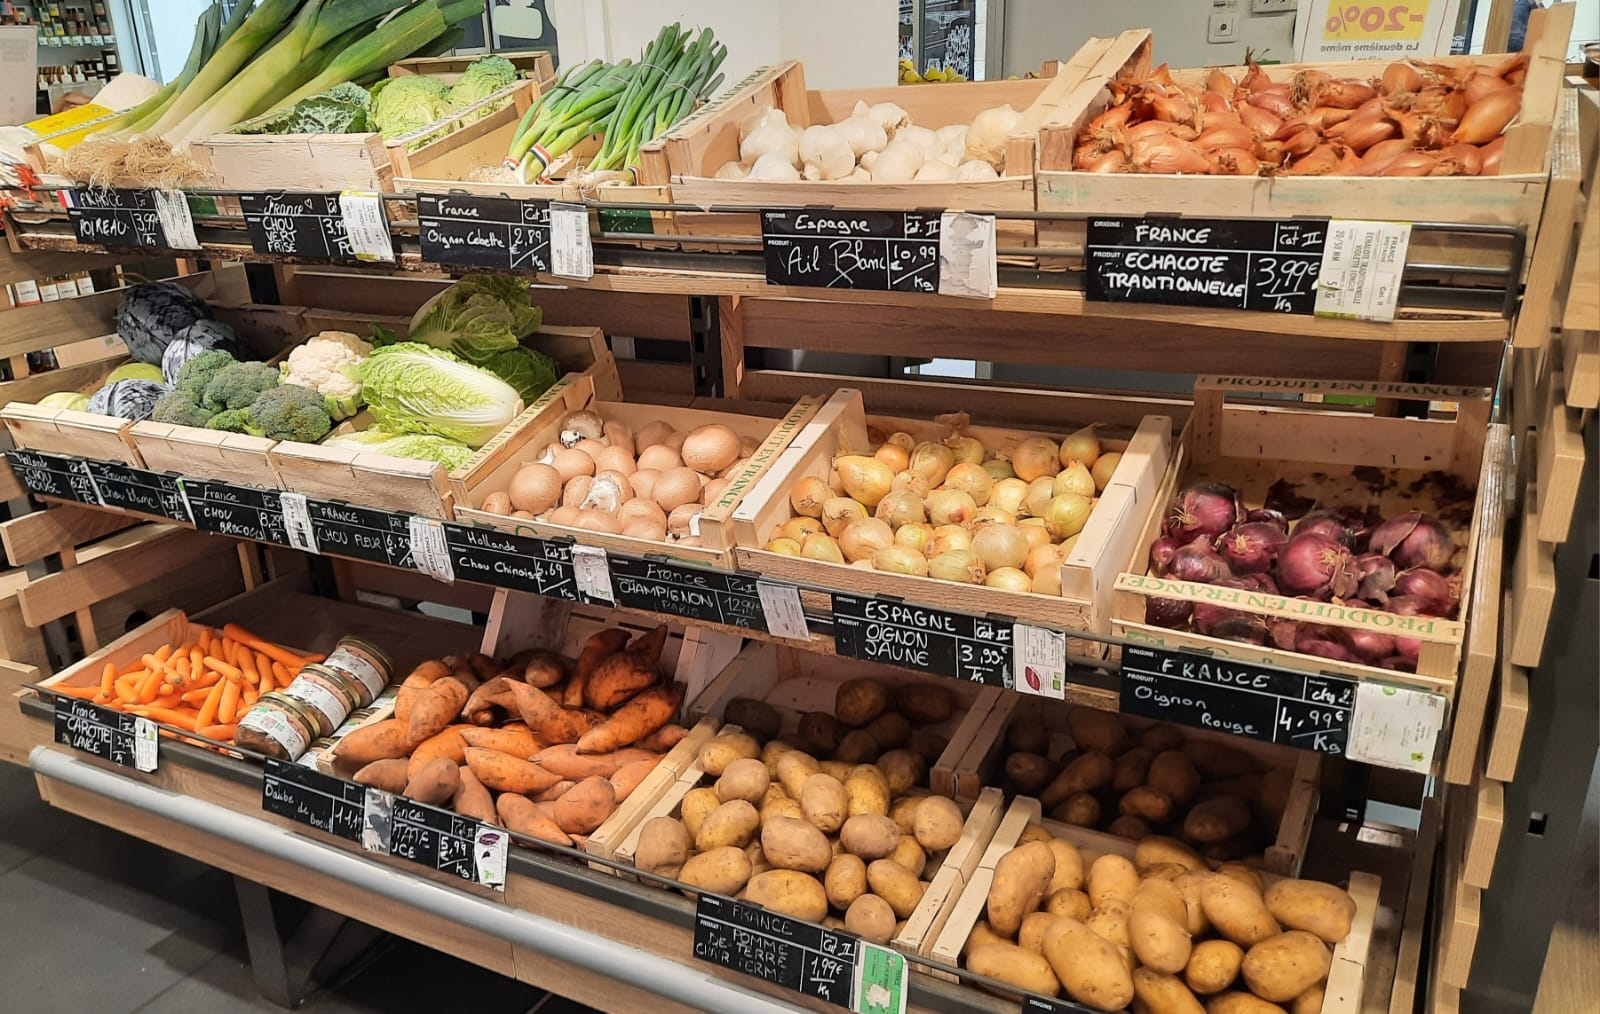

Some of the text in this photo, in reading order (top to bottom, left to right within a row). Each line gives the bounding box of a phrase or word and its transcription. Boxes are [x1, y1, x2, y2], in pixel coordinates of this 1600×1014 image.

[438, 199, 479, 217] France
[262, 216, 293, 231] CHOU
[795, 214, 870, 234] Espagne
[925, 220, 941, 237] II
[1135, 224, 1211, 244] FRANCE
[265, 230, 297, 242] VERT
[427, 229, 465, 249] Oignon
[1279, 231, 1323, 247] Cat II
[532, 254, 545, 270] Kg
[788, 240, 886, 288] Ail Blanc
[1125, 252, 1229, 273] ECHALOTE
[914, 275, 934, 291] Kg
[1102, 272, 1246, 298] TRADITIONNELLE
[1255, 257, 1320, 293] 3,99€
[1216, 376, 1484, 398] PRODUIT EN FRANCE
[204, 485, 238, 500] France
[204, 507, 232, 519] CHOU
[320, 507, 358, 523] FRANCE
[317, 528, 382, 549] CHOU FLEUR
[467, 531, 518, 552] Hollande
[459, 556, 537, 580] Chou Chinois
[647, 564, 709, 588] France
[619, 581, 714, 608] CHAMPIGNON
[1128, 576, 1436, 634] PRODUIT EN FRANCE
[865, 600, 956, 632] ESPAGNE
[866, 623, 928, 648] OIGNON
[976, 626, 1011, 641] Cat II
[864, 640, 929, 666] JAUNE
[1162, 658, 1270, 688] FRANCE
[1135, 686, 1207, 710] Oignon
[67, 717, 111, 743] CAROTTE
[1201, 712, 1258, 734] Rouge
[1313, 733, 1341, 754] Kg
[265, 784, 294, 804] Daube
[297, 801, 309, 815] de
[732, 904, 794, 936] FRANCE
[733, 928, 788, 956] POMME
[736, 942, 787, 968] TERRE
